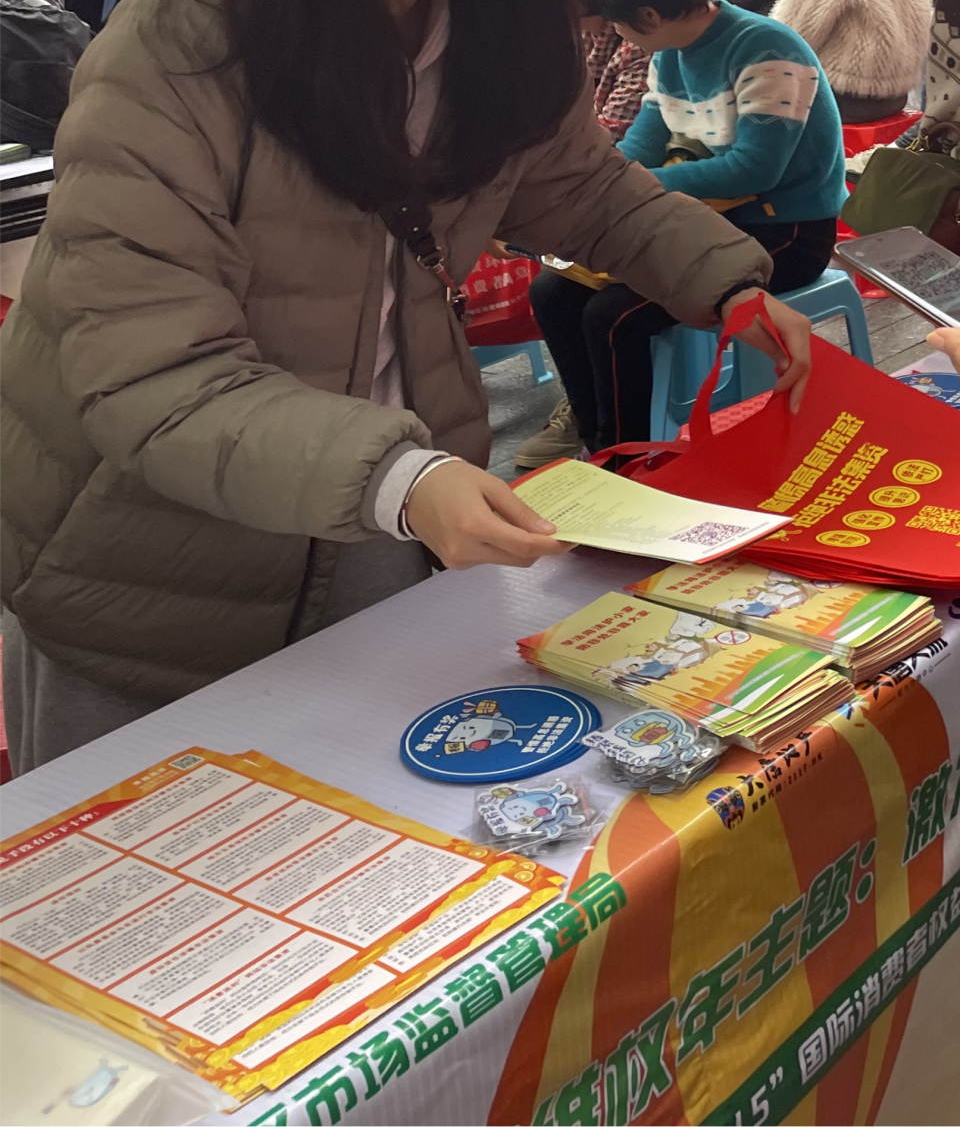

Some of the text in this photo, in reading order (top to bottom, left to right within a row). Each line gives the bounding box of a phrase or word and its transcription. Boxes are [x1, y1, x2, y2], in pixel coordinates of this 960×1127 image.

[757, 411, 865, 513] 警惕高息诱惑
[791, 442, 889, 528] 拒绝非法集资
[415, 714, 459, 752] 举报有奖
